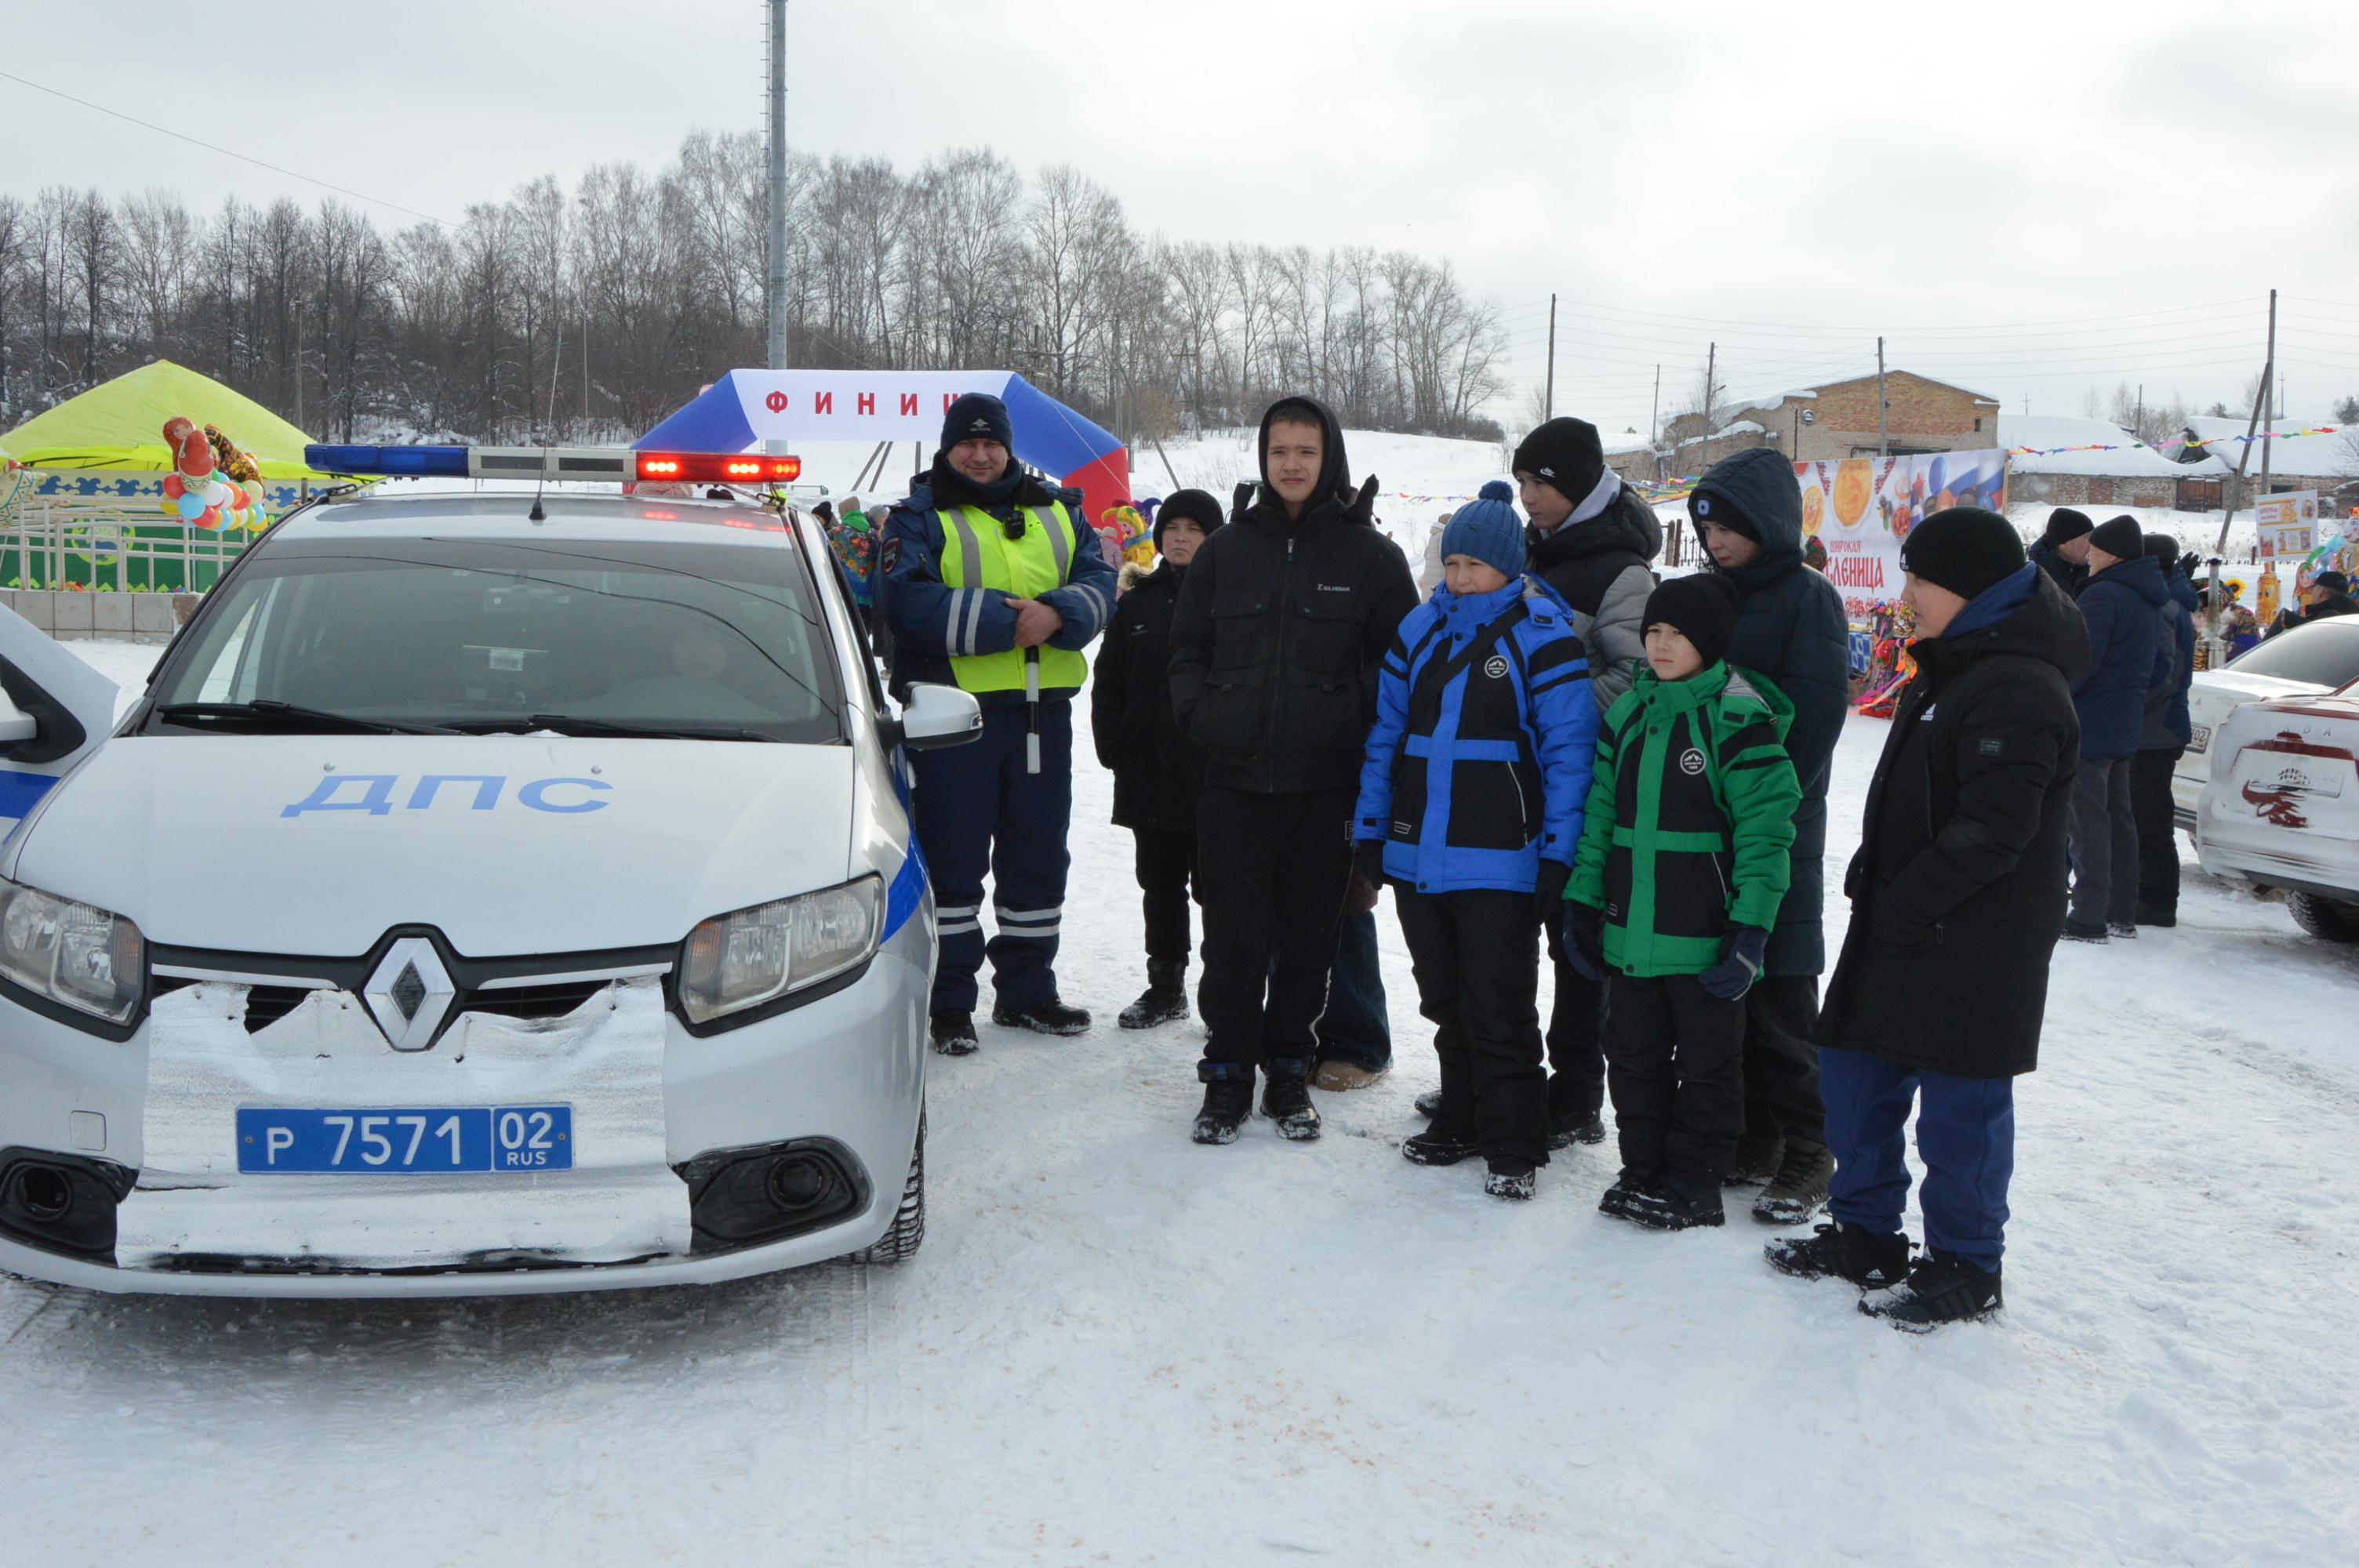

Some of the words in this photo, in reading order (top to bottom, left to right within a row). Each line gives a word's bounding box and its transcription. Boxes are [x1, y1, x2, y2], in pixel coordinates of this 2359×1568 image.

[1830, 540, 1861, 553] ШИРОКАЯ
[1822, 557, 1884, 594] СЛЕНИЦА
[280, 775, 613, 818] ДПС
[324, 1115, 460, 1166] 7571
[500, 1112, 553, 1150] 02
[507, 1151, 547, 1166] RUS
